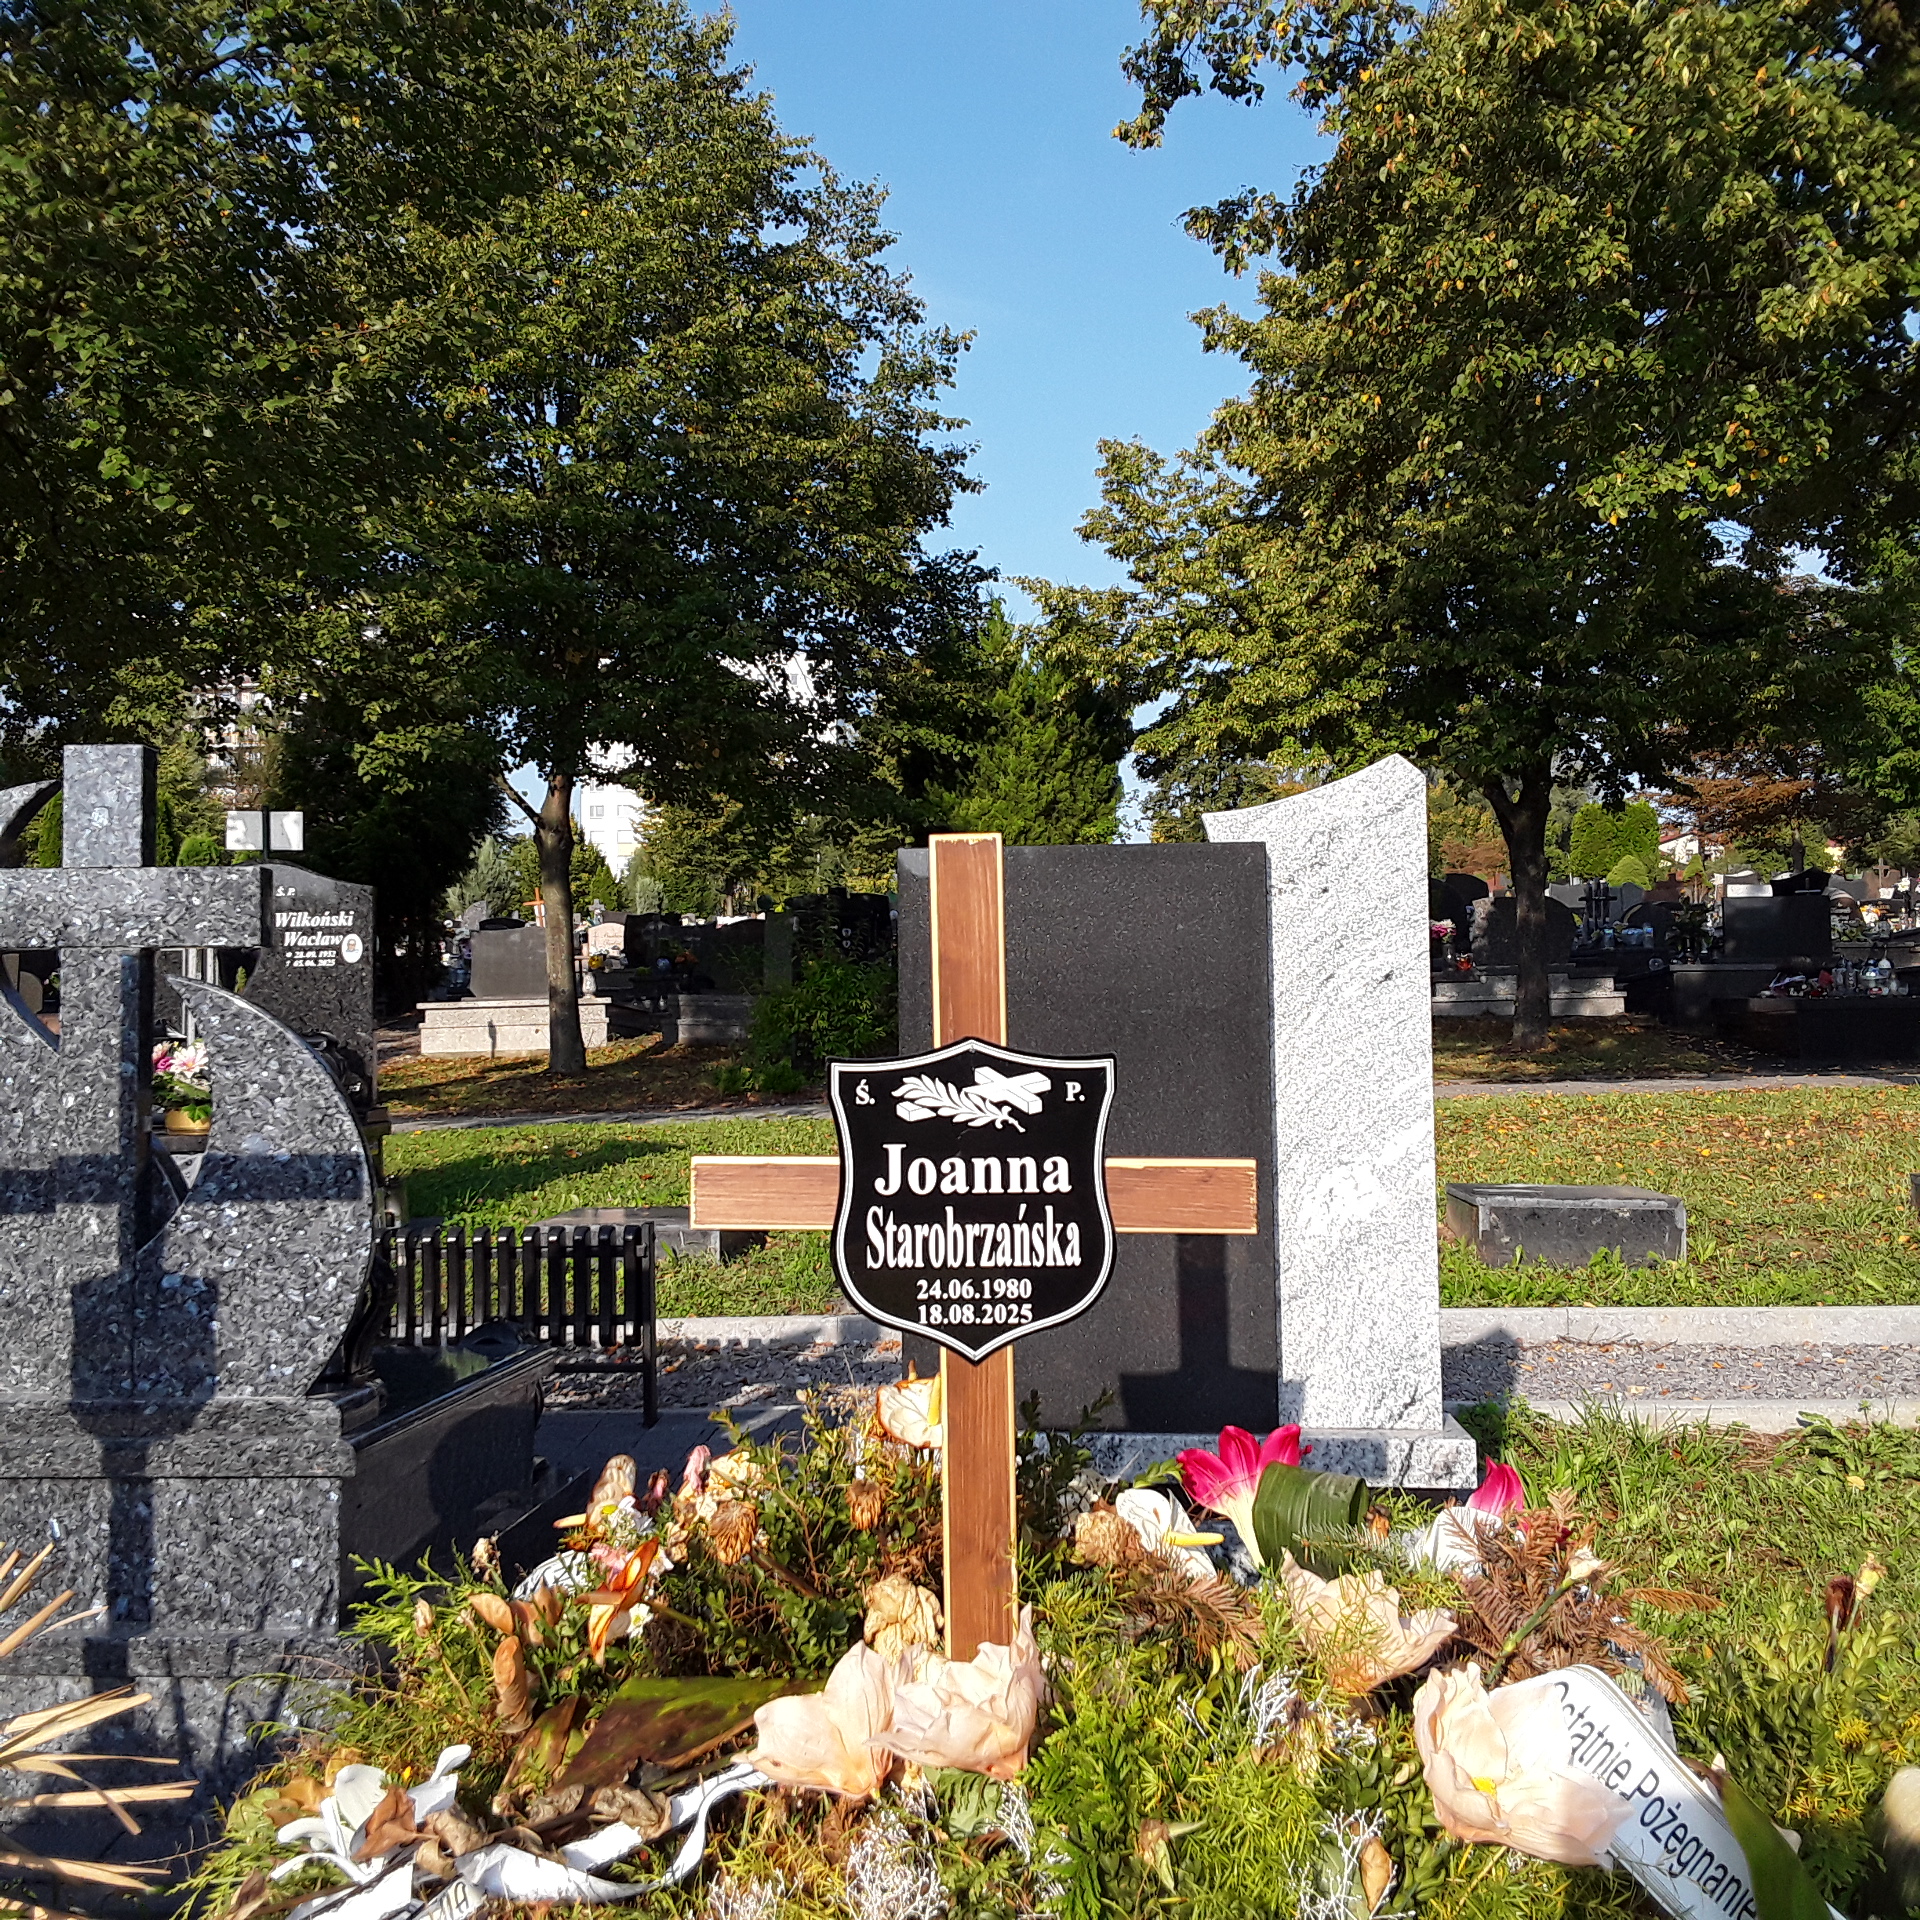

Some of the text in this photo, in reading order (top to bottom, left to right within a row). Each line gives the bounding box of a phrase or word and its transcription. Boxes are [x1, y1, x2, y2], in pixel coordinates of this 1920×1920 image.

[275, 911, 355, 928] Wilkoński
[283, 931, 343, 947] Wacław
[855, 1078, 1086, 1105] Ś. P.
[874, 1143, 1072, 1196] Joanna
[865, 1203, 1082, 1269] Starobrzańska
[916, 1278, 1032, 1300] 24.06.1980
[917, 1303, 1033, 1325] 18.08.2025
